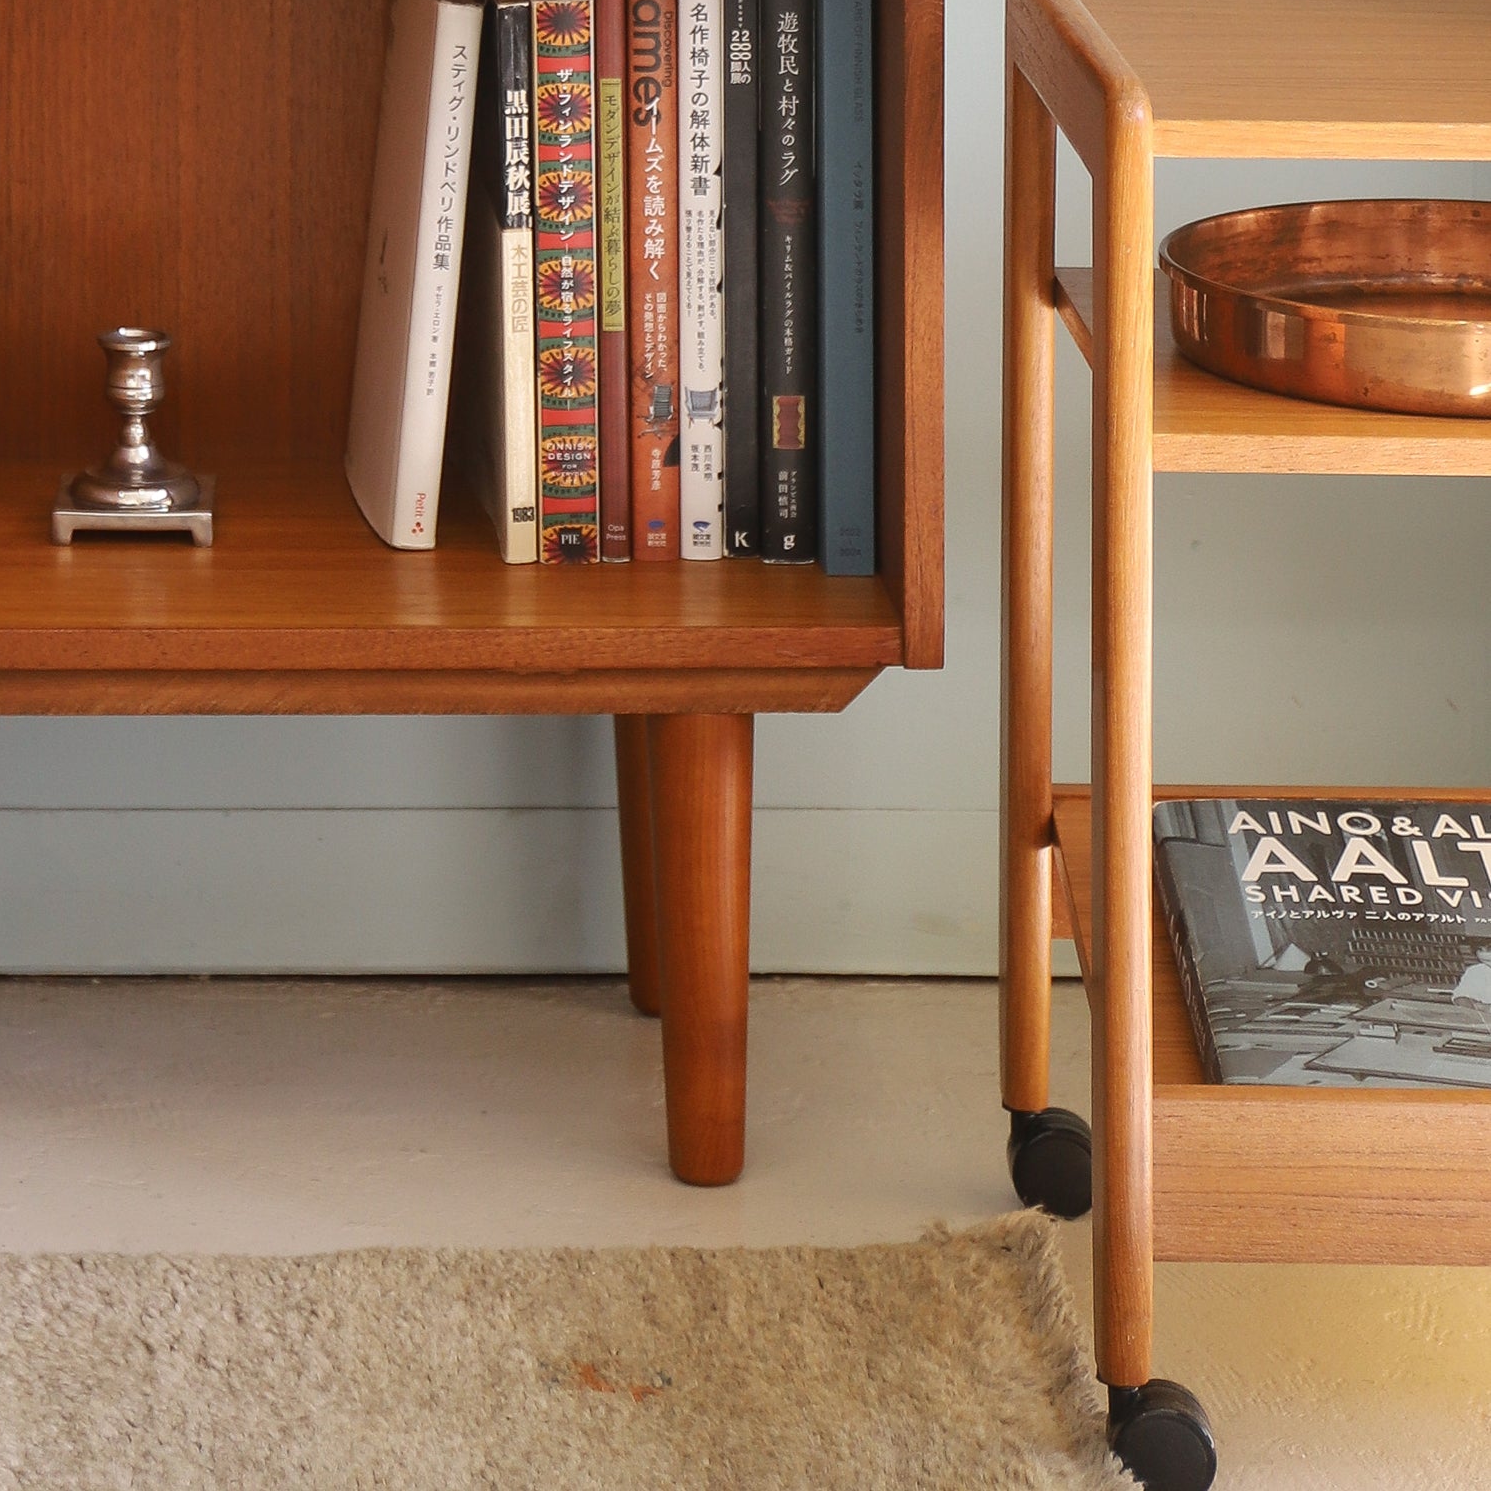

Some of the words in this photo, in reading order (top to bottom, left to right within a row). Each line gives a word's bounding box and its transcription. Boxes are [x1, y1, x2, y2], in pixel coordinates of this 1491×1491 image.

[662, 11, 674, 88] Discovering
[689, 3, 710, 196] 名作椅子の解体新書
[777, 12, 799, 186] 遊牧民と村々のラグ
[433, 45, 468, 271] スティグ・リンドベリ作品集
[504, 90, 532, 216] 黒田辰秋展
[643, 96, 665, 281] イームズを読み解く
[604, 95, 621, 315] モダンデザインが結ぶ暮らしの夢
[511, 244, 529, 333] 木工芸の匠
[546, 442, 592, 451] FINNISH
[547, 452, 591, 461] DESIGN
[413, 492, 427, 517] Petit
[511, 507, 535, 523] 1983
[561, 533, 581, 545] PIE
[606, 533, 626, 542] Press
[608, 524, 624, 534] Opa
[734, 530, 750, 548] K
[782, 534, 796, 550] g
[1244, 884, 1423, 905] SHARED
[1365, 911, 1467, 924] 二人のアアルト
